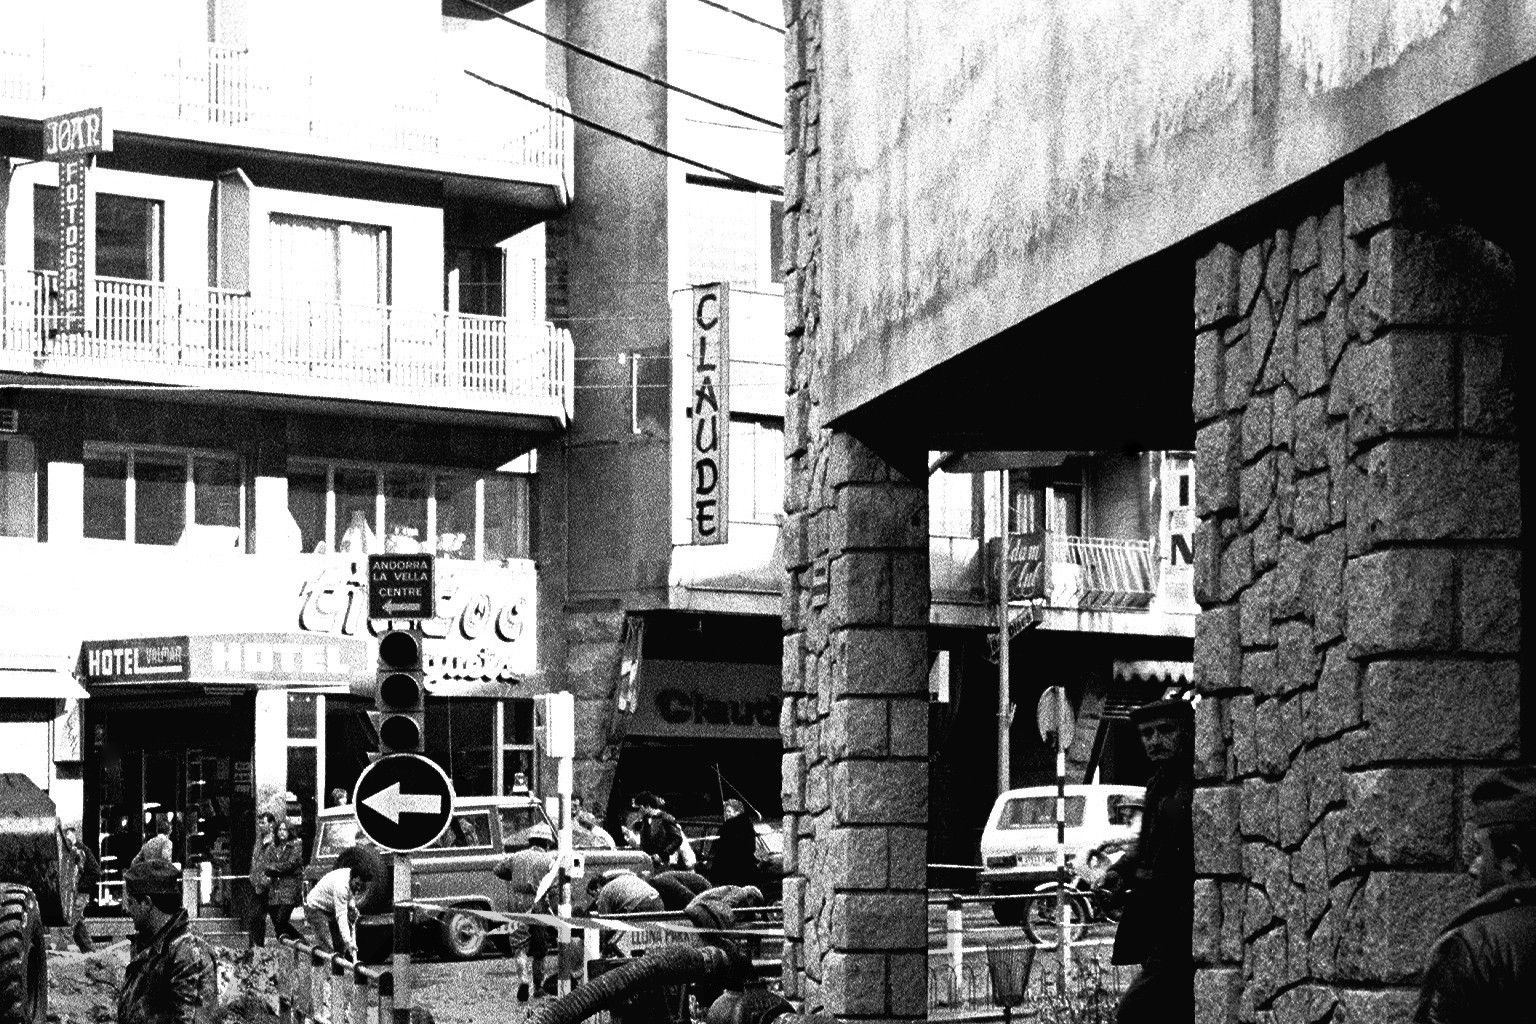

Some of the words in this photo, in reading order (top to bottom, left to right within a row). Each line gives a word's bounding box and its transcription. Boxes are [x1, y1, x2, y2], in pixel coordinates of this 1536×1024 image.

[695, 293, 719, 537] CLAUDE
[373, 560, 428, 570] ANDORRA
[373, 572, 387, 581] LA
[394, 572, 428, 581] VELLA
[378, 587, 422, 597] CENTRE
[89, 647, 140, 676] HOTEL
[211, 642, 351, 673] HOTEL
[655, 687, 780, 727] Claud
